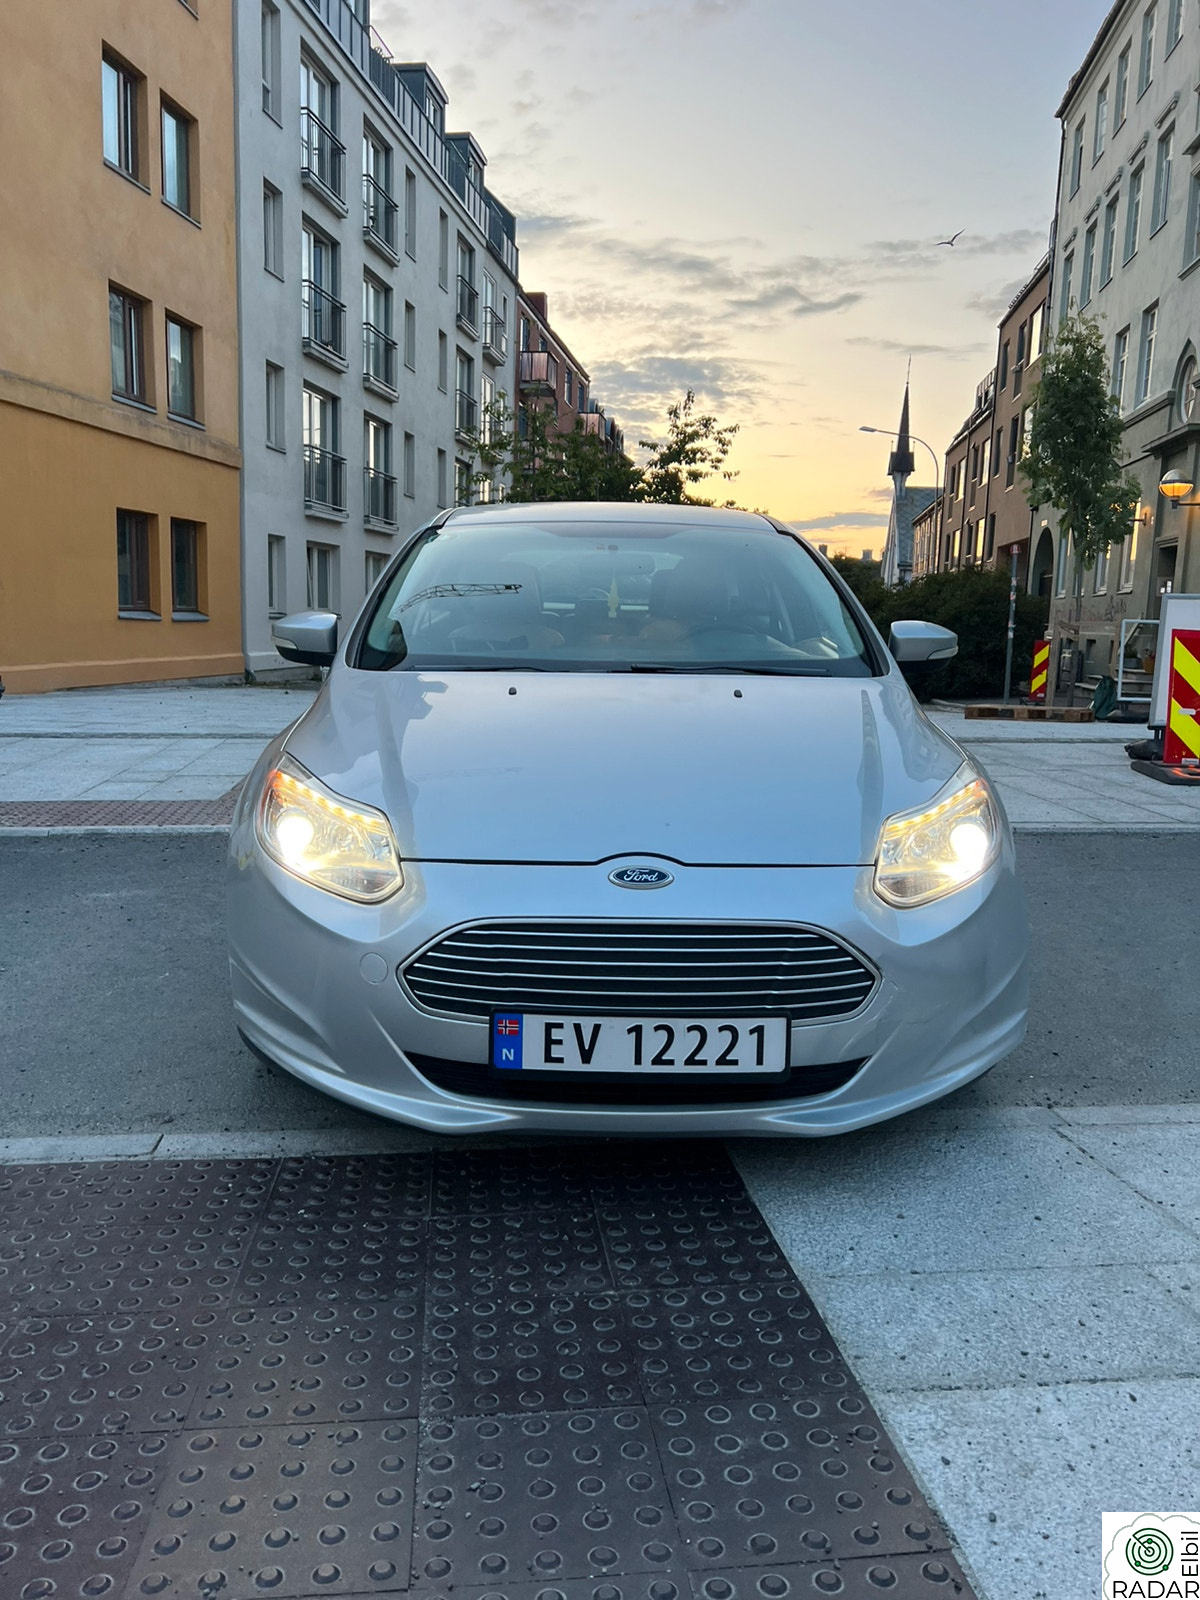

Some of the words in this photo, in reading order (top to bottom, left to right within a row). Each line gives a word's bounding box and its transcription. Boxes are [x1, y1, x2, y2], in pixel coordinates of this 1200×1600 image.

[623, 868, 659, 882] Ford
[543, 1021, 602, 1065] EV
[626, 1023, 766, 1066] 12221
[501, 1048, 514, 1061] N
